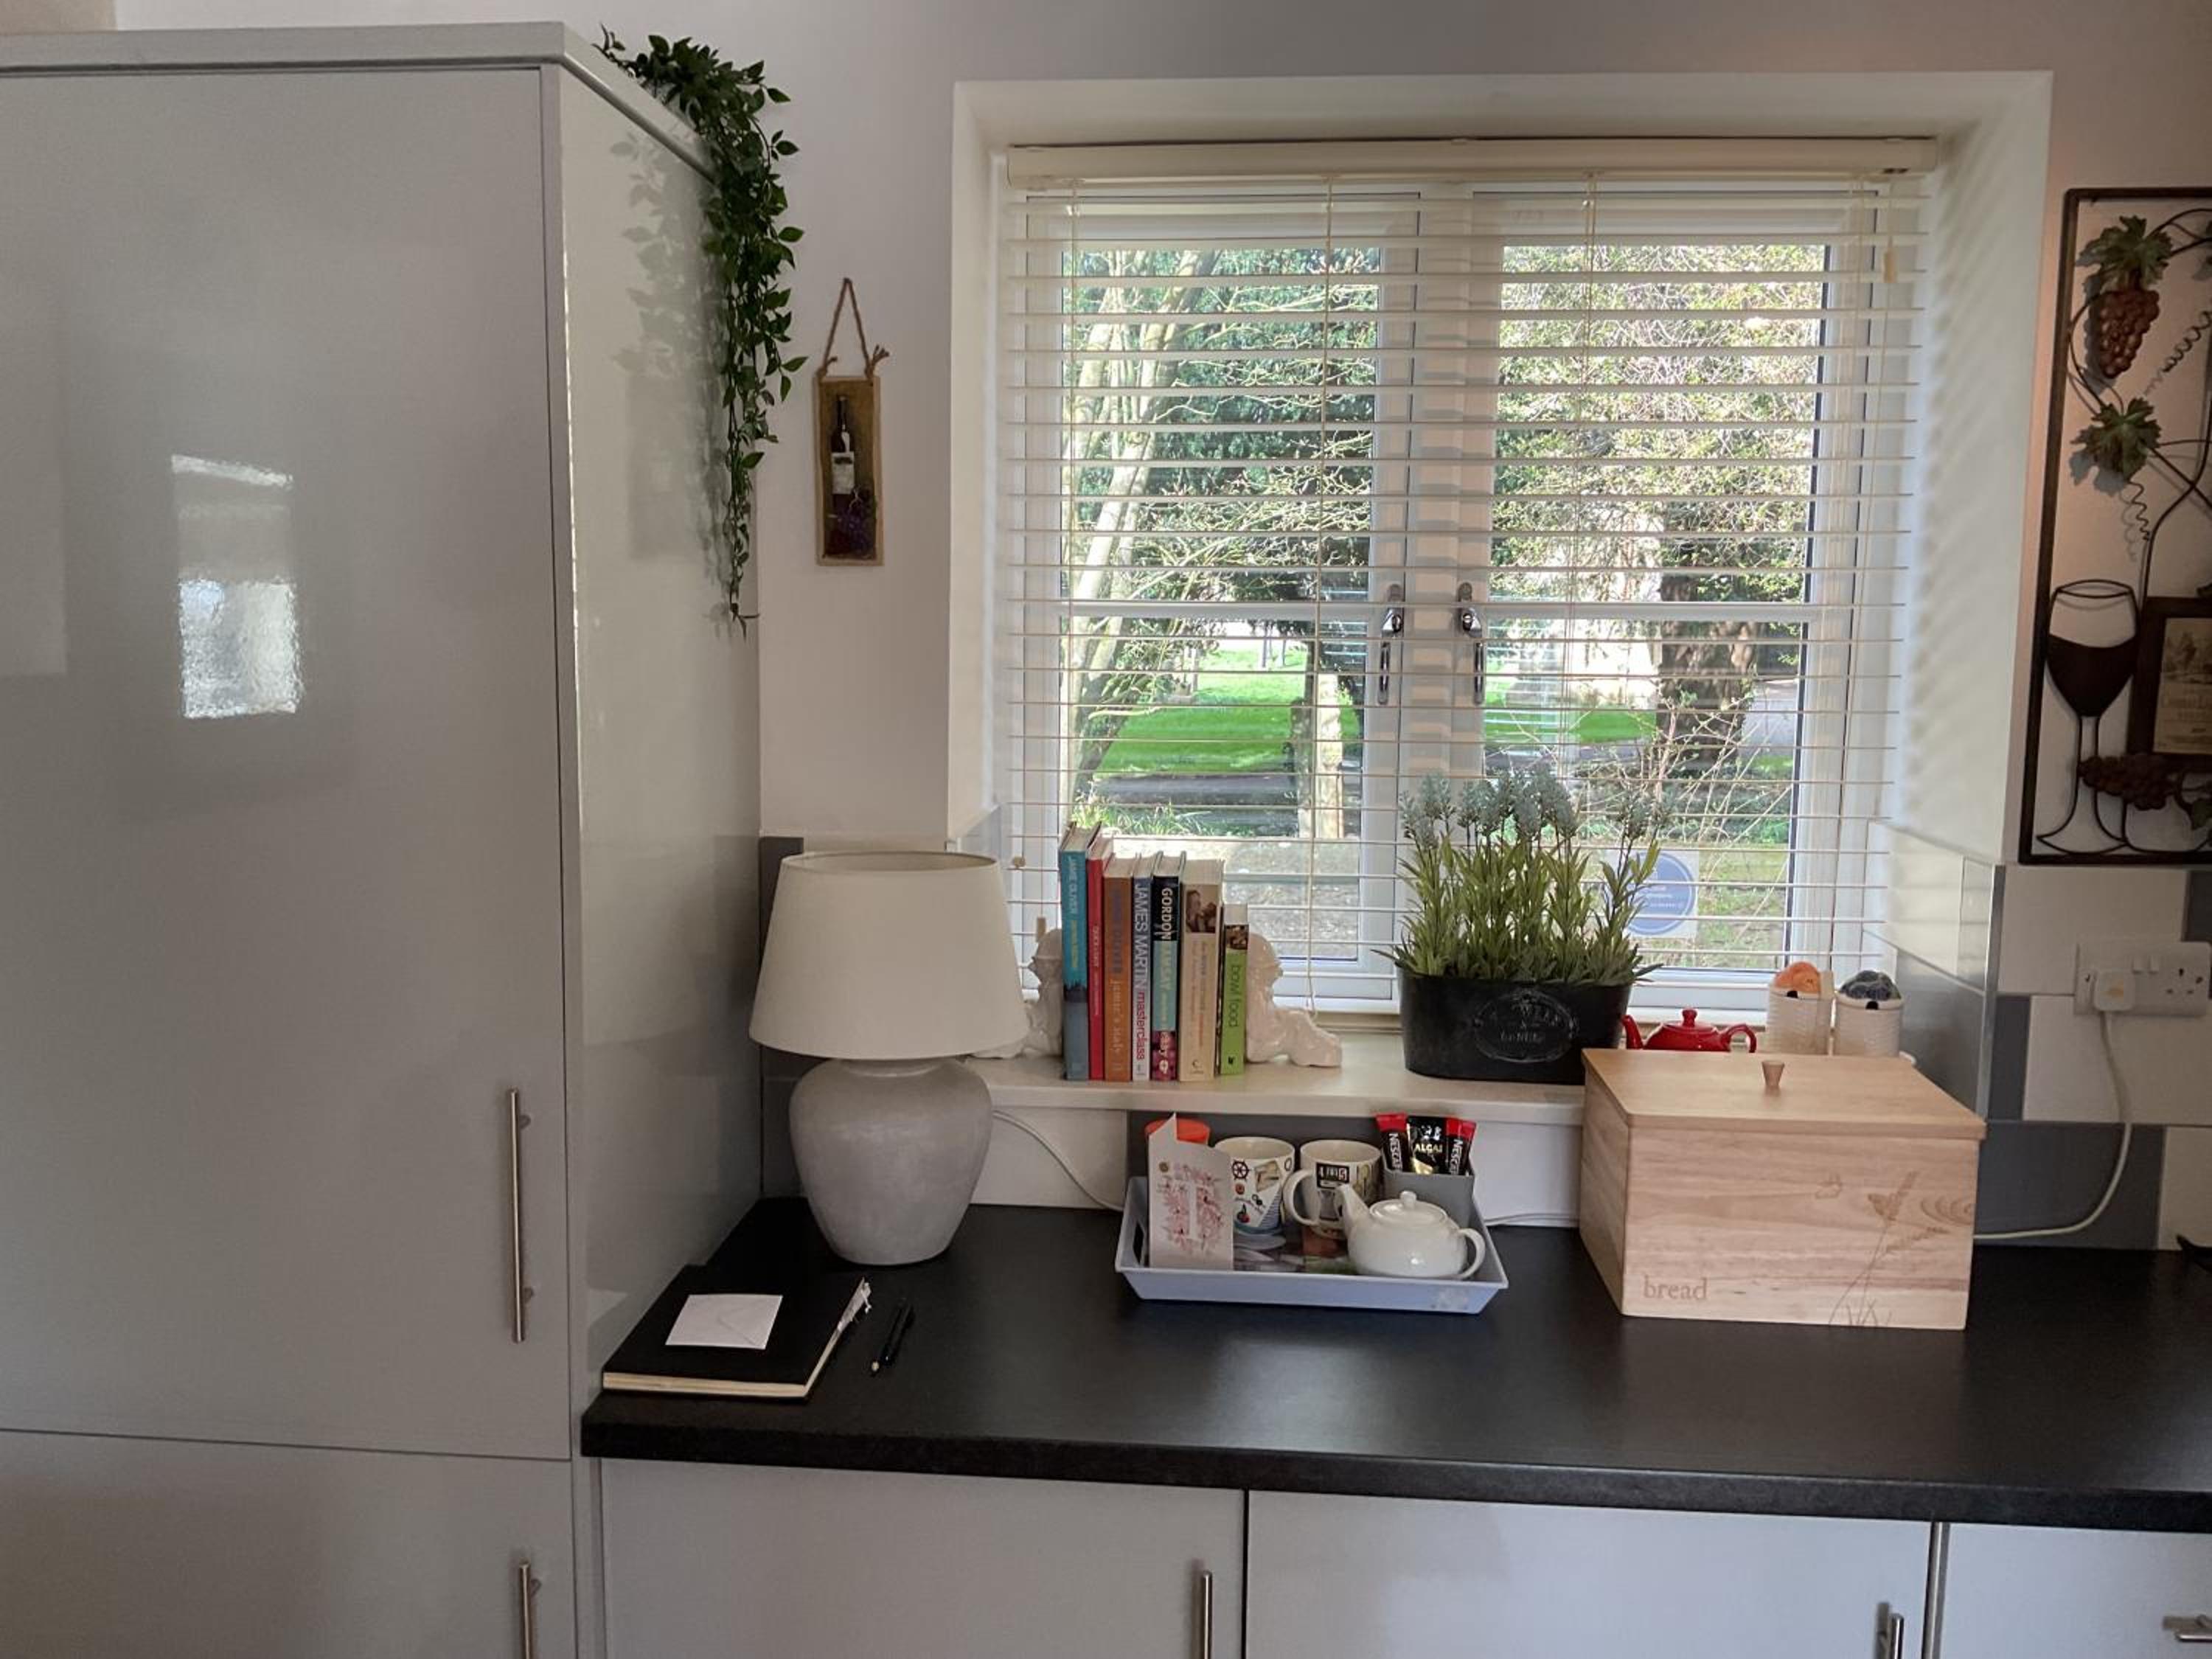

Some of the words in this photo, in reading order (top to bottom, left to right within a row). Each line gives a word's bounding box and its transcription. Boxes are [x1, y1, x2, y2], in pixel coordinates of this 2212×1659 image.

[1135, 884, 1148, 932] JAMES
[1161, 887, 1173, 941] GORDON
[1135, 934, 1148, 990] MARTIN
[1229, 964, 1242, 996] bowl
[1135, 990, 1146, 1060] masterclass
[1644, 1273, 1709, 1301] bread
